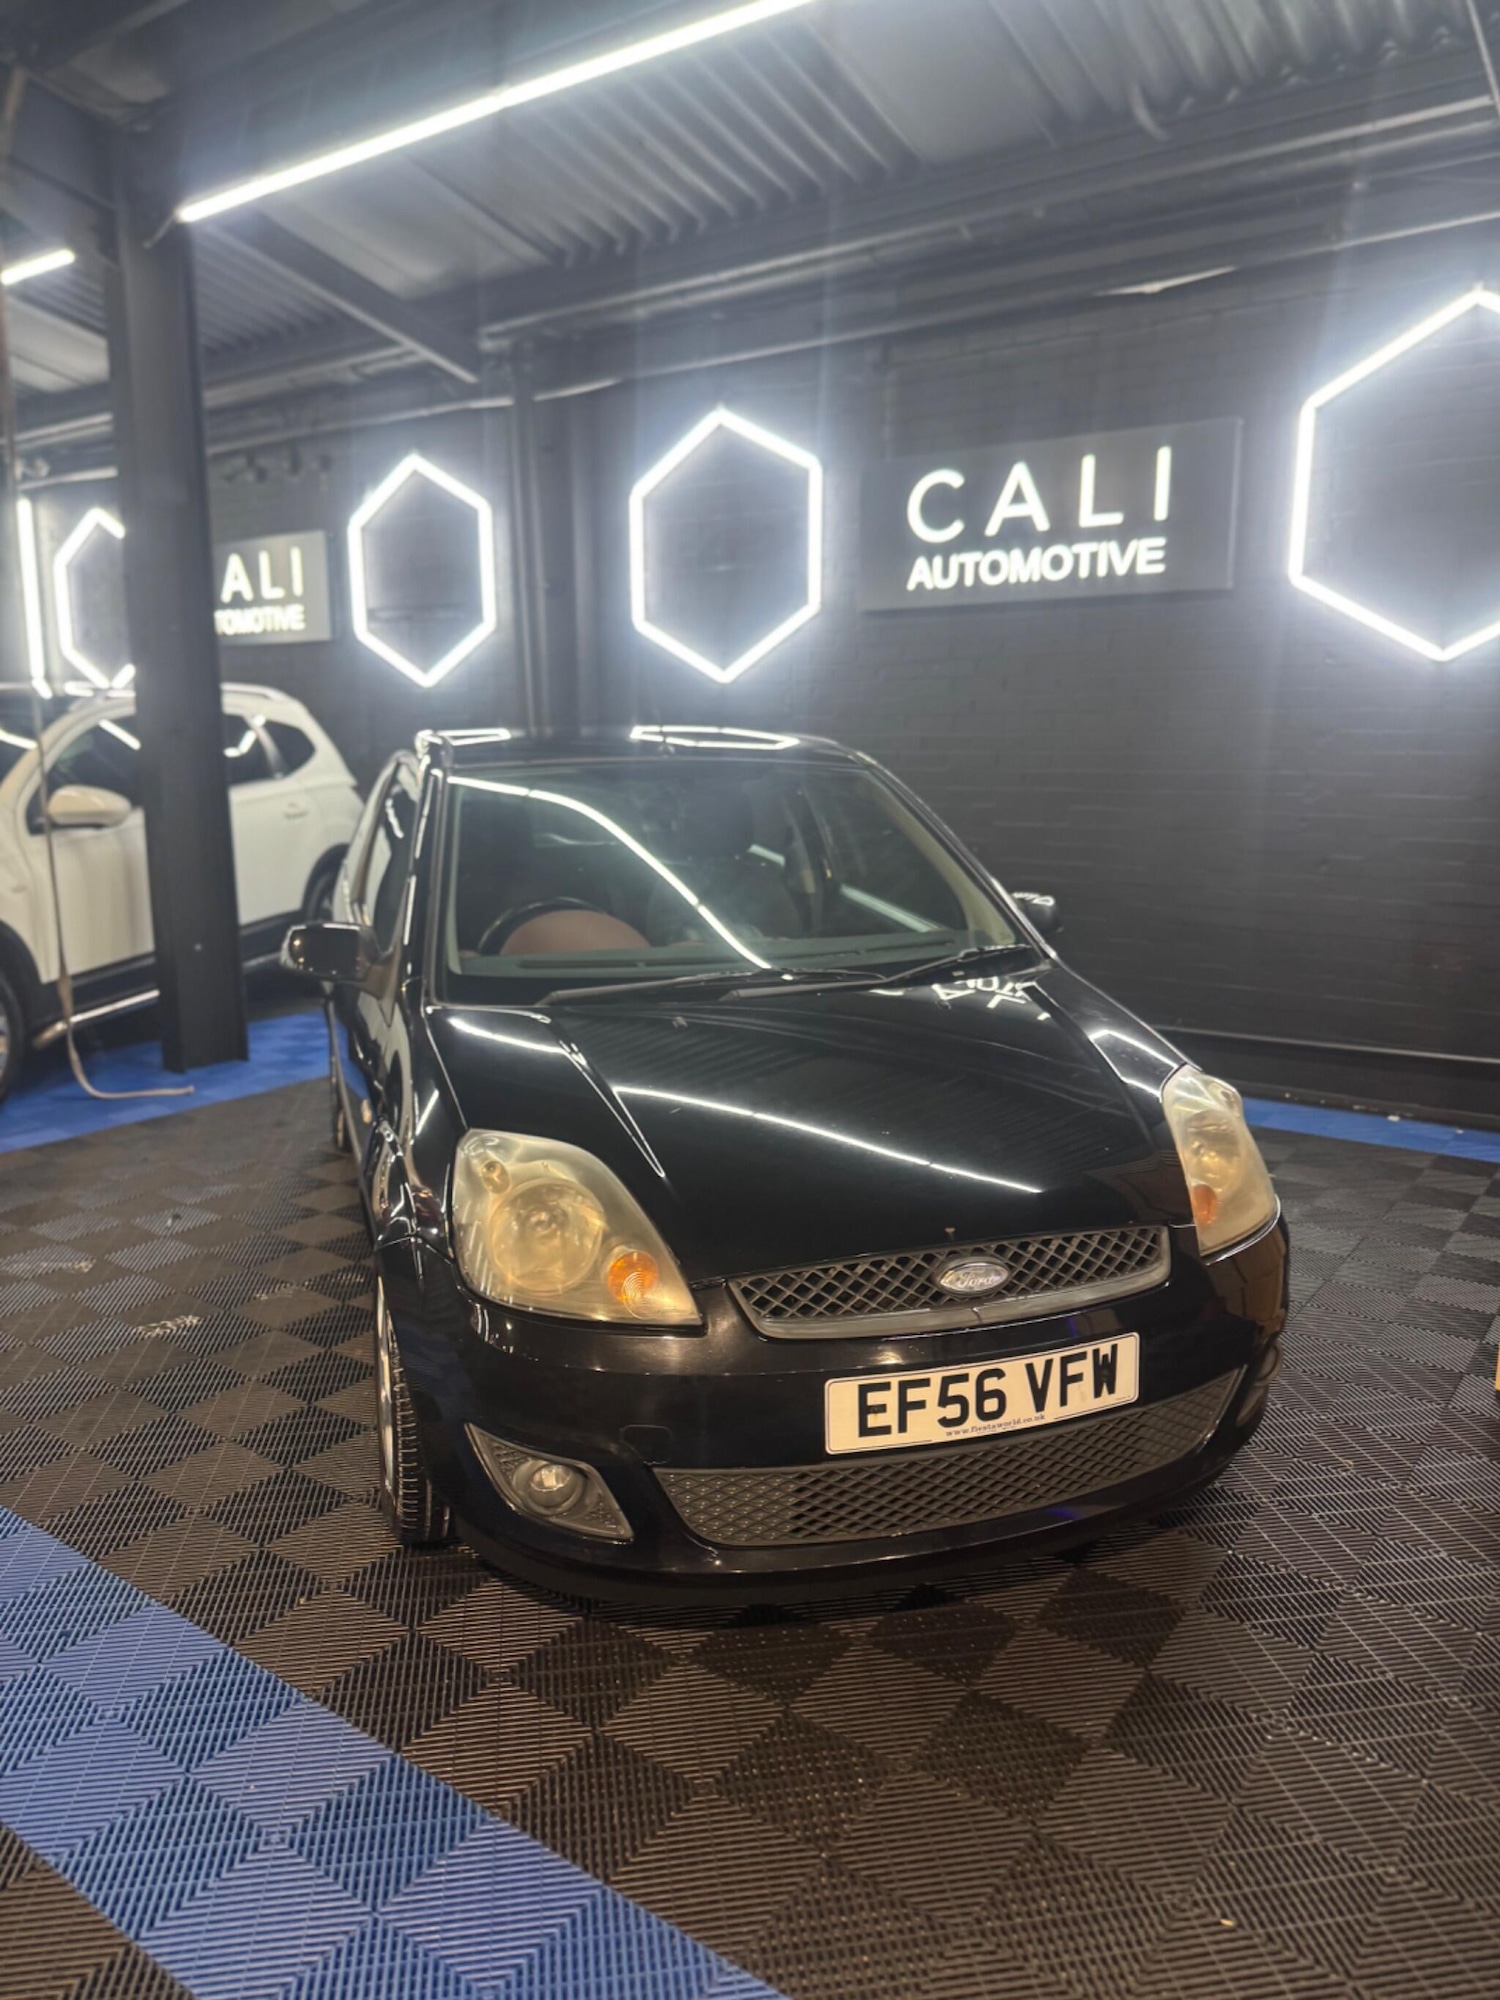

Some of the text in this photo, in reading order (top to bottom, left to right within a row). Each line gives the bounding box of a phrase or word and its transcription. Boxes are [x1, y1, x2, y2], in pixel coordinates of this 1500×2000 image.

[907, 446, 1171, 543] CALI
[220, 546, 303, 604] ALI
[906, 536, 1167, 591] AUTOMOTIVE
[213, 603, 306, 635] TOMOTIVE
[858, 1343, 1118, 1438] EF56 VFW
